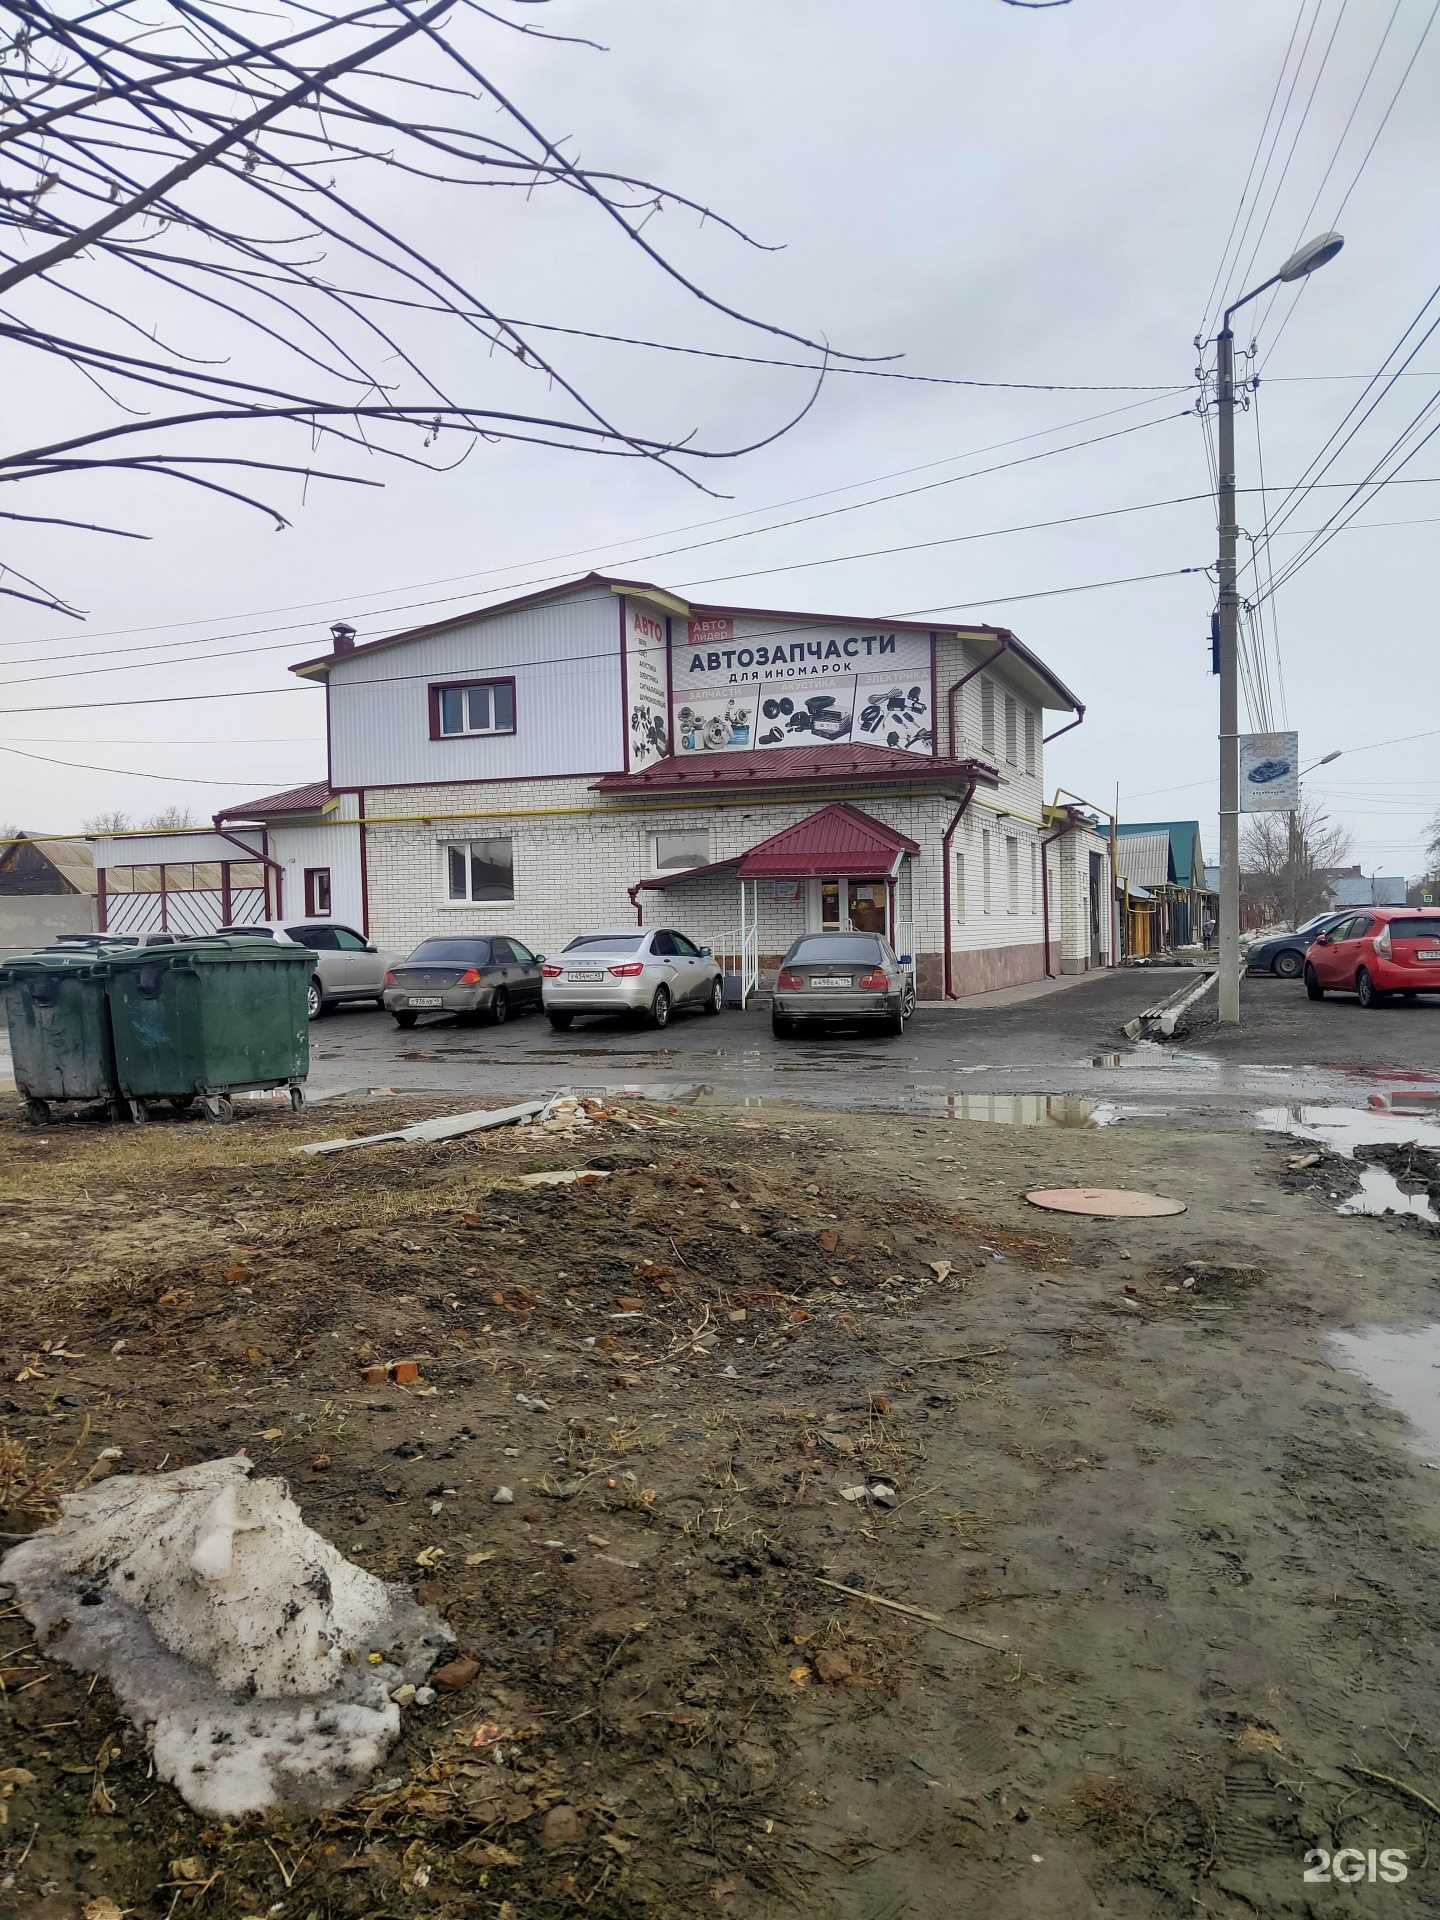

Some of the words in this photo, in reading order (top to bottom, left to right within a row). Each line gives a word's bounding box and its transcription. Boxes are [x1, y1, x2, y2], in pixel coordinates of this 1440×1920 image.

[634, 613, 662, 641] АВТО
[693, 619, 727, 633] АВТО
[689, 634, 896, 672] АВТОЗАПЧАСТИ
[729, 671, 759, 684] ДЛЯ
[765, 662, 851, 678] ИНОМАРОК
[689, 688, 742, 700] ЗАПЧАСТИ
